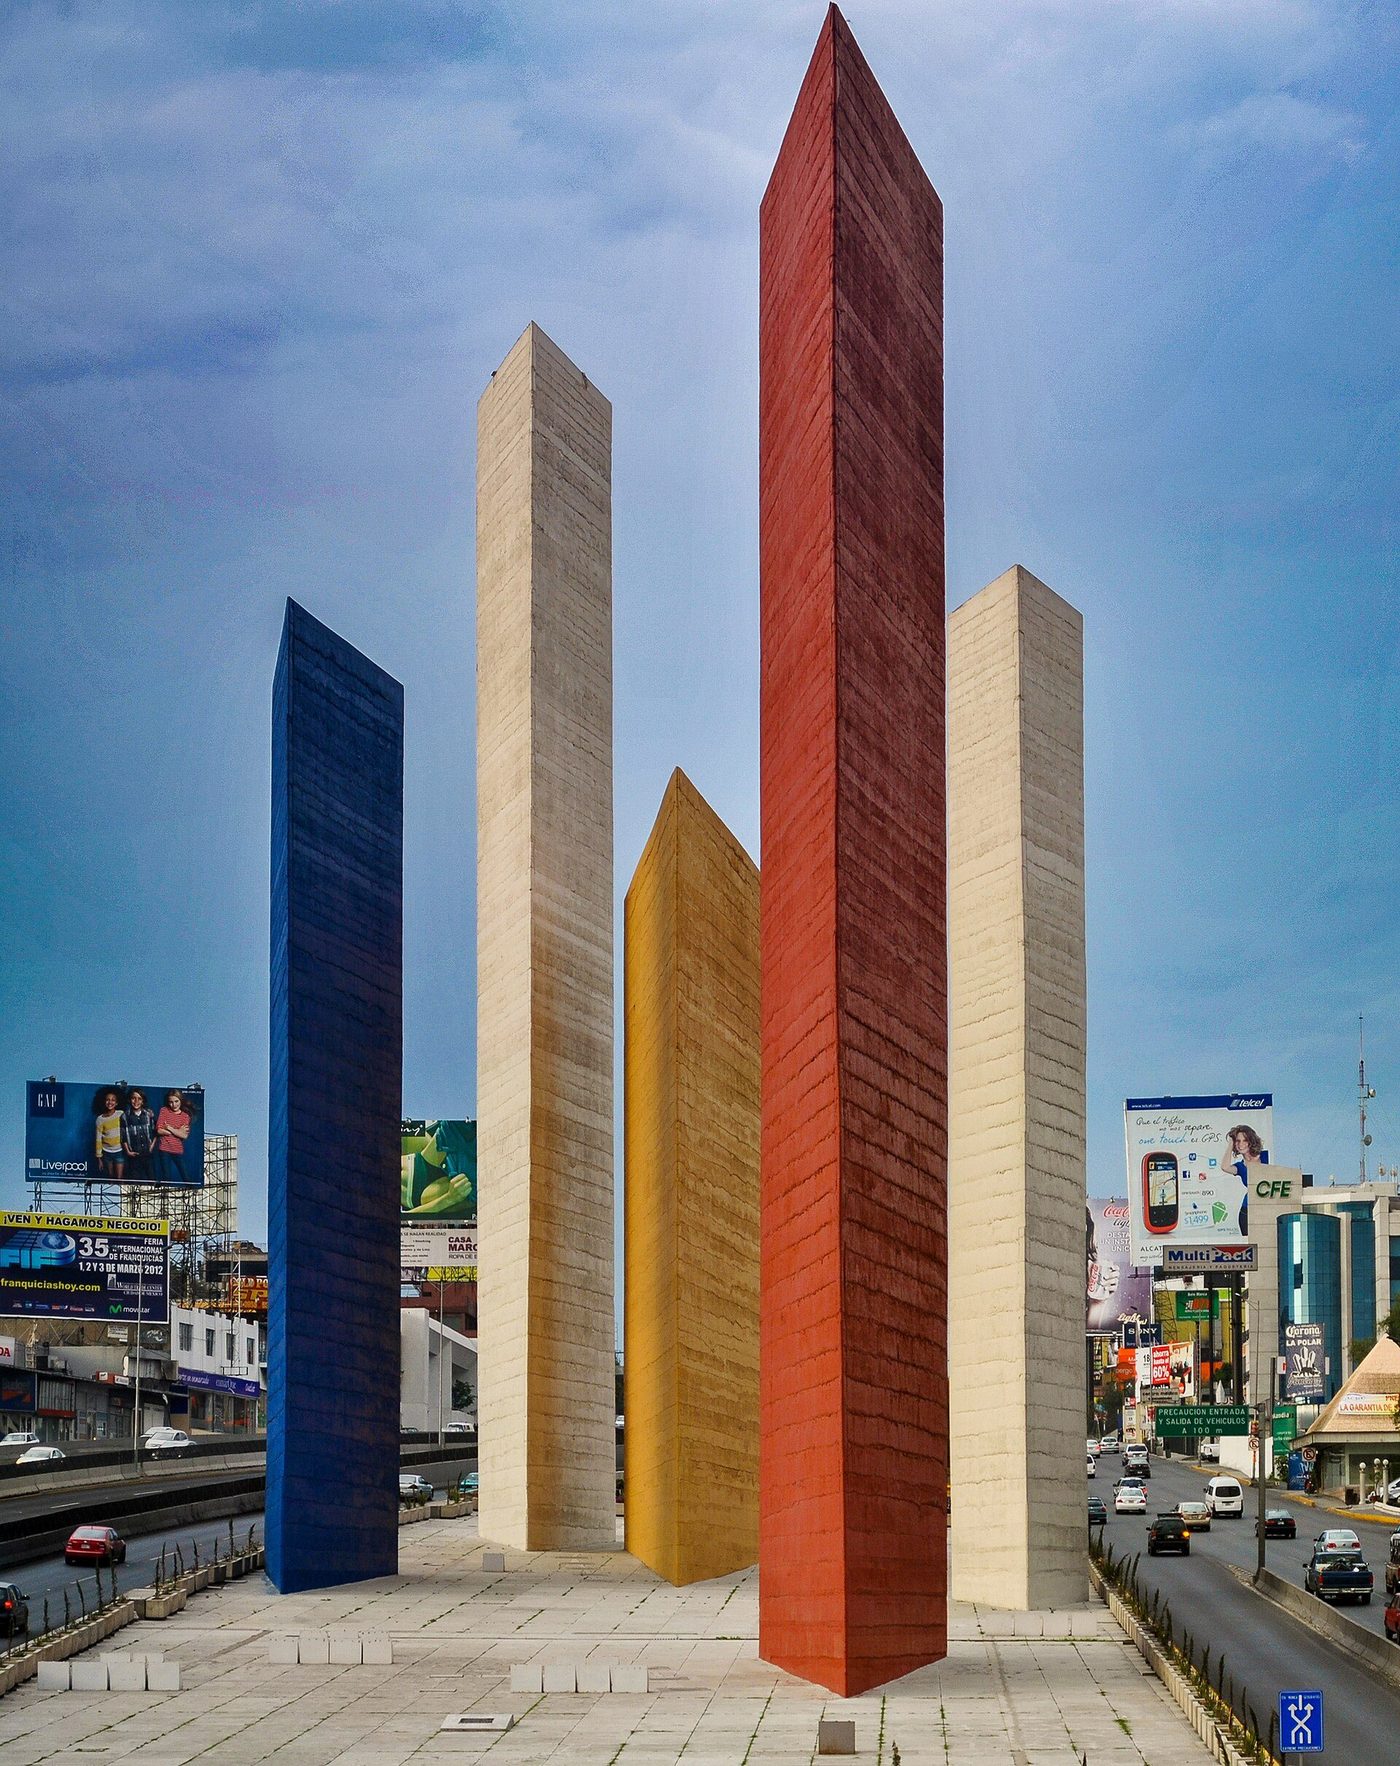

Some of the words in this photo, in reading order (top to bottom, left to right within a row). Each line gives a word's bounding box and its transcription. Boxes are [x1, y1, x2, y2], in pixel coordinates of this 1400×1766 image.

[37, 1093, 57, 1108] GAP
[1239, 1098, 1265, 1108] telcel
[1159, 1132, 1187, 1144] touch
[41, 1160, 88, 1172] Liverpool
[1256, 1180, 1292, 1198] CFE
[4, 1214, 31, 1224] ¡VEN
[35, 1216, 42, 1224] Y
[46, 1217, 103, 1228] HAGAMOS
[107, 1222, 161, 1232] NEGOCIO!
[79, 1237, 109, 1257] 35
[144, 1238, 164, 1246] FERIA
[113, 1245, 164, 1254] TERNACIONAL
[1168, 1250, 1210, 1261] Multi
[1215, 1248, 1252, 1261] Pack
[120, 1254, 164, 1263] FRANQUICIAS
[85, 1262, 92, 1271] 2
[92, 1262, 98, 1272] Y
[99, 1263, 105, 1272] 3
[106, 1263, 116, 1273] DE
[144, 1265, 164, 1275] 2012
[0, 1278, 101, 1292] franquiciashoy.com
[123, 1305, 150, 1314] movitar
[1285, 1325, 1321, 1338] Corona
[1286, 1339, 1296, 1347] LA
[1297, 1338, 1322, 1346] POLAR
[1153, 1365, 1170, 1379] 60%
[1158, 1408, 1207, 1416] PRECAUCION
[1350, 1403, 1382, 1411] GARANTIA
